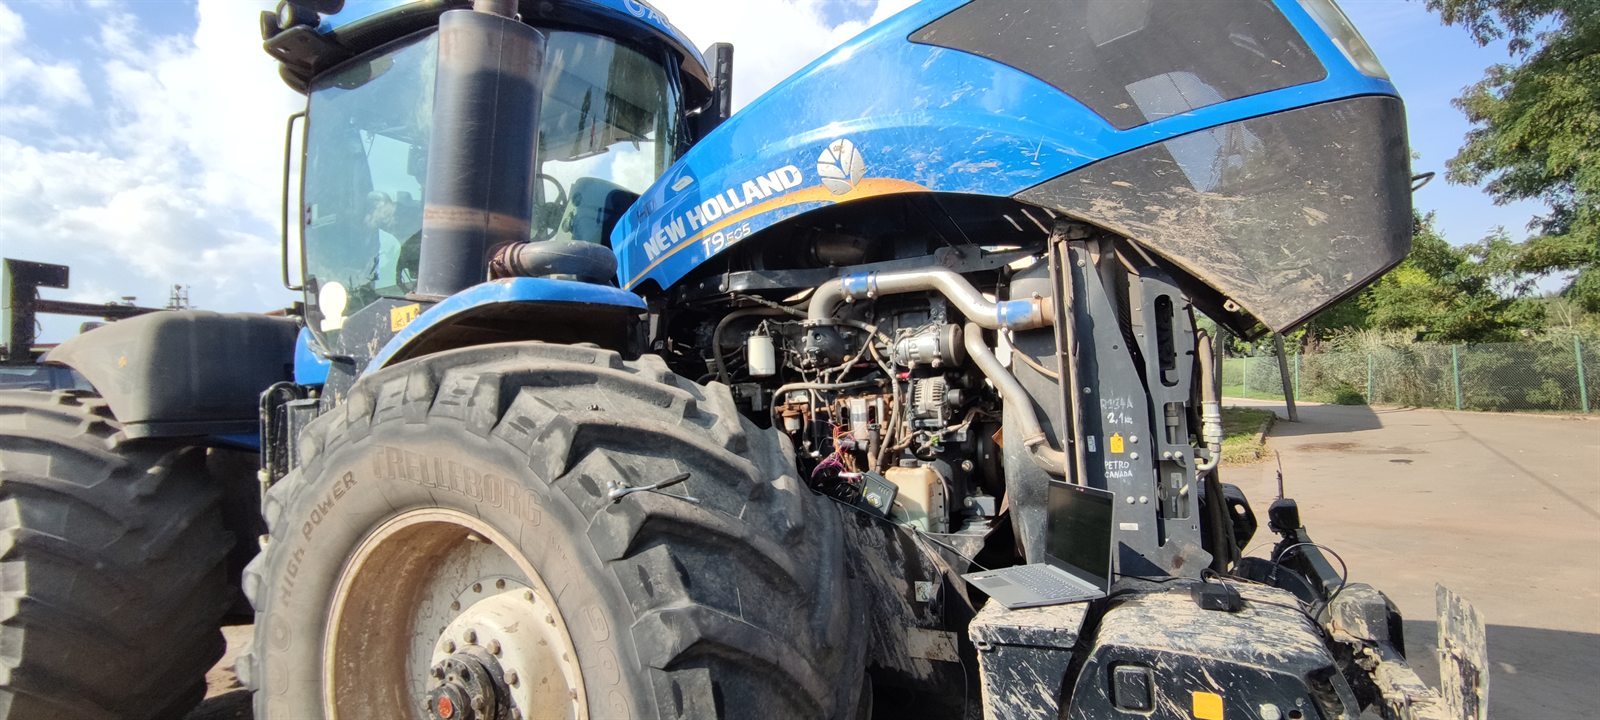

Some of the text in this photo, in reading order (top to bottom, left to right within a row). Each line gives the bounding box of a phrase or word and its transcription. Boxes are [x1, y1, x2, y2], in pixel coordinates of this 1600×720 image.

[642, 164, 803, 261] NEW HOLLAND
[372, 445, 543, 528] TRELLEBORG
[1104, 460, 1130, 470] PETRO
[1104, 469, 1134, 479] CANADA
[278, 470, 358, 607] HIGH POWER
